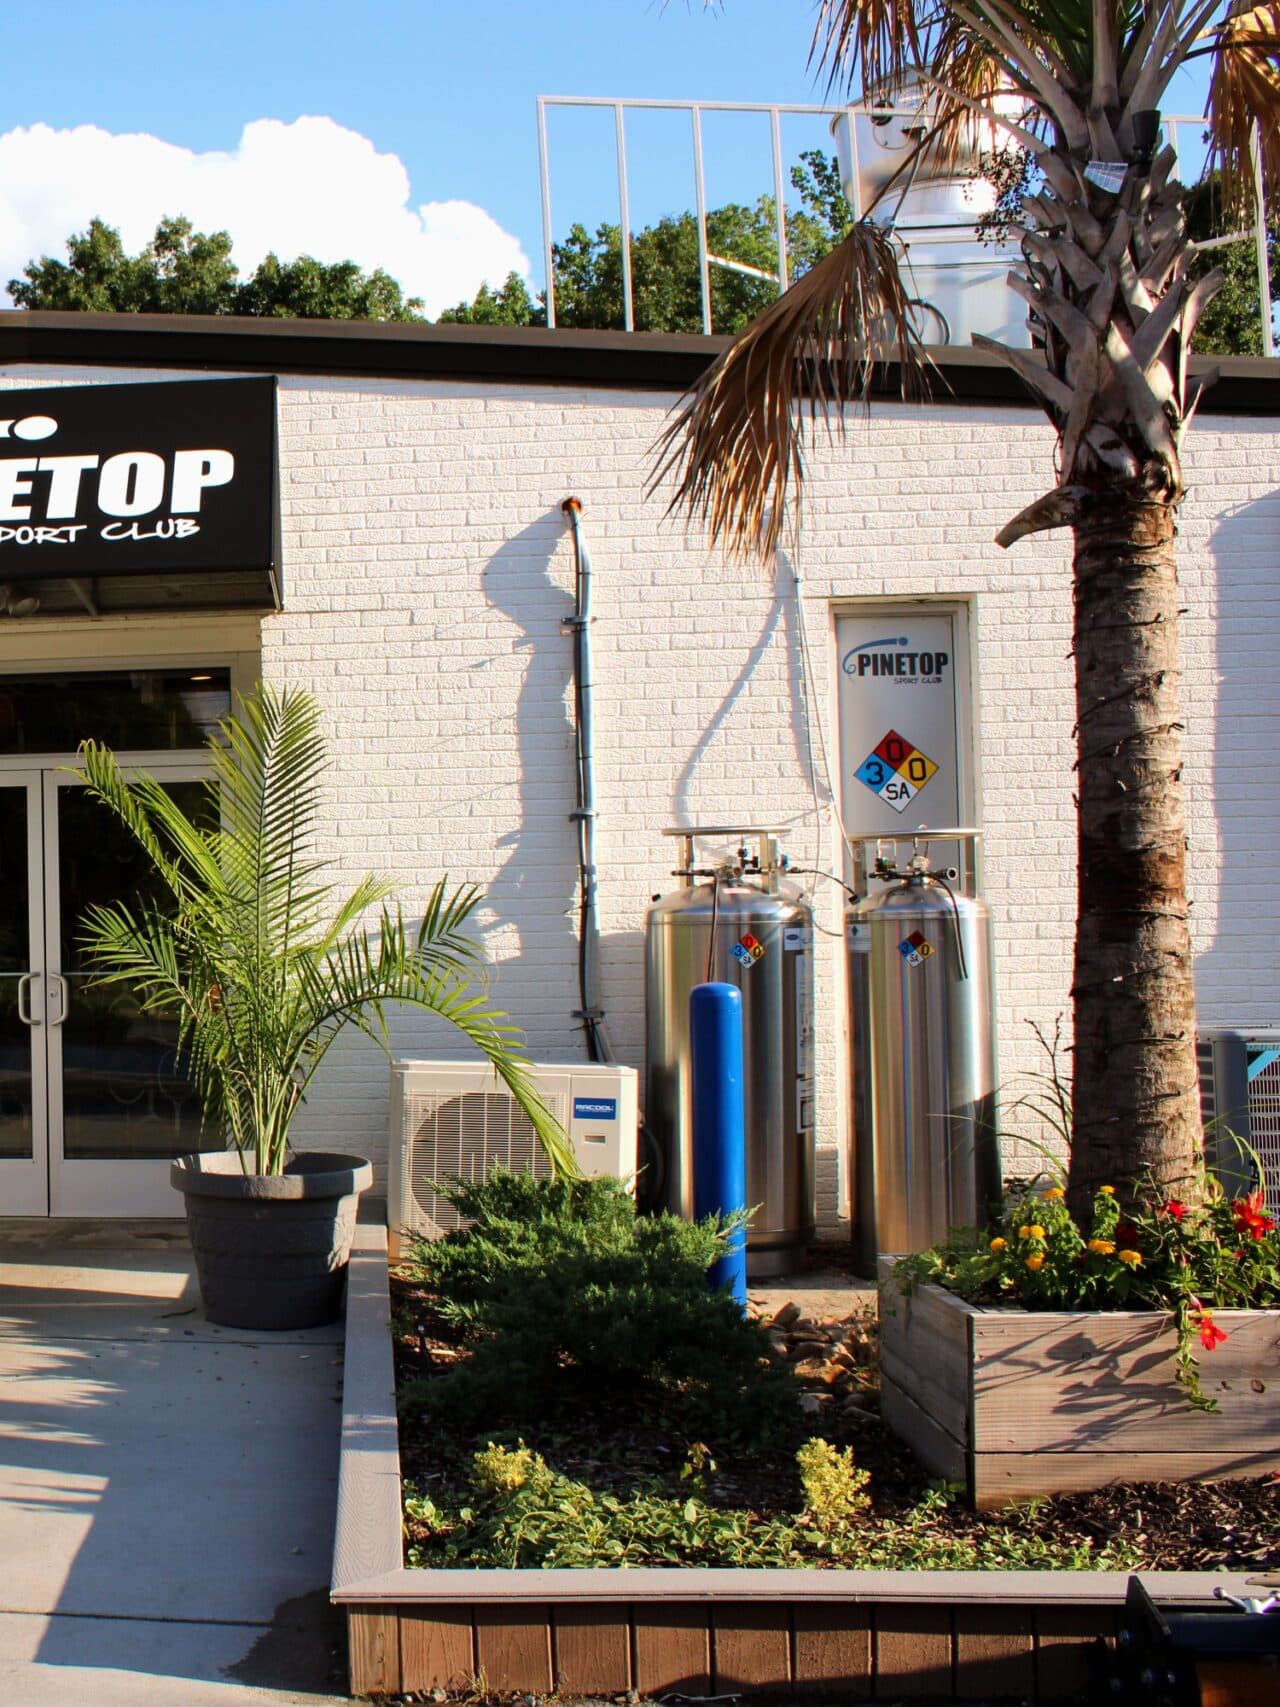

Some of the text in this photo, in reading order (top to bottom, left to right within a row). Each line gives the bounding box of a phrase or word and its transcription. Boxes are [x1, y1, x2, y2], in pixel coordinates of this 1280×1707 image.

[100, 518, 201, 542] CLUB
[857, 652, 949, 677] PINETOP
[885, 738, 904, 763] 0
[865, 757, 926, 786] 3 0
[885, 782, 910, 801] SA
